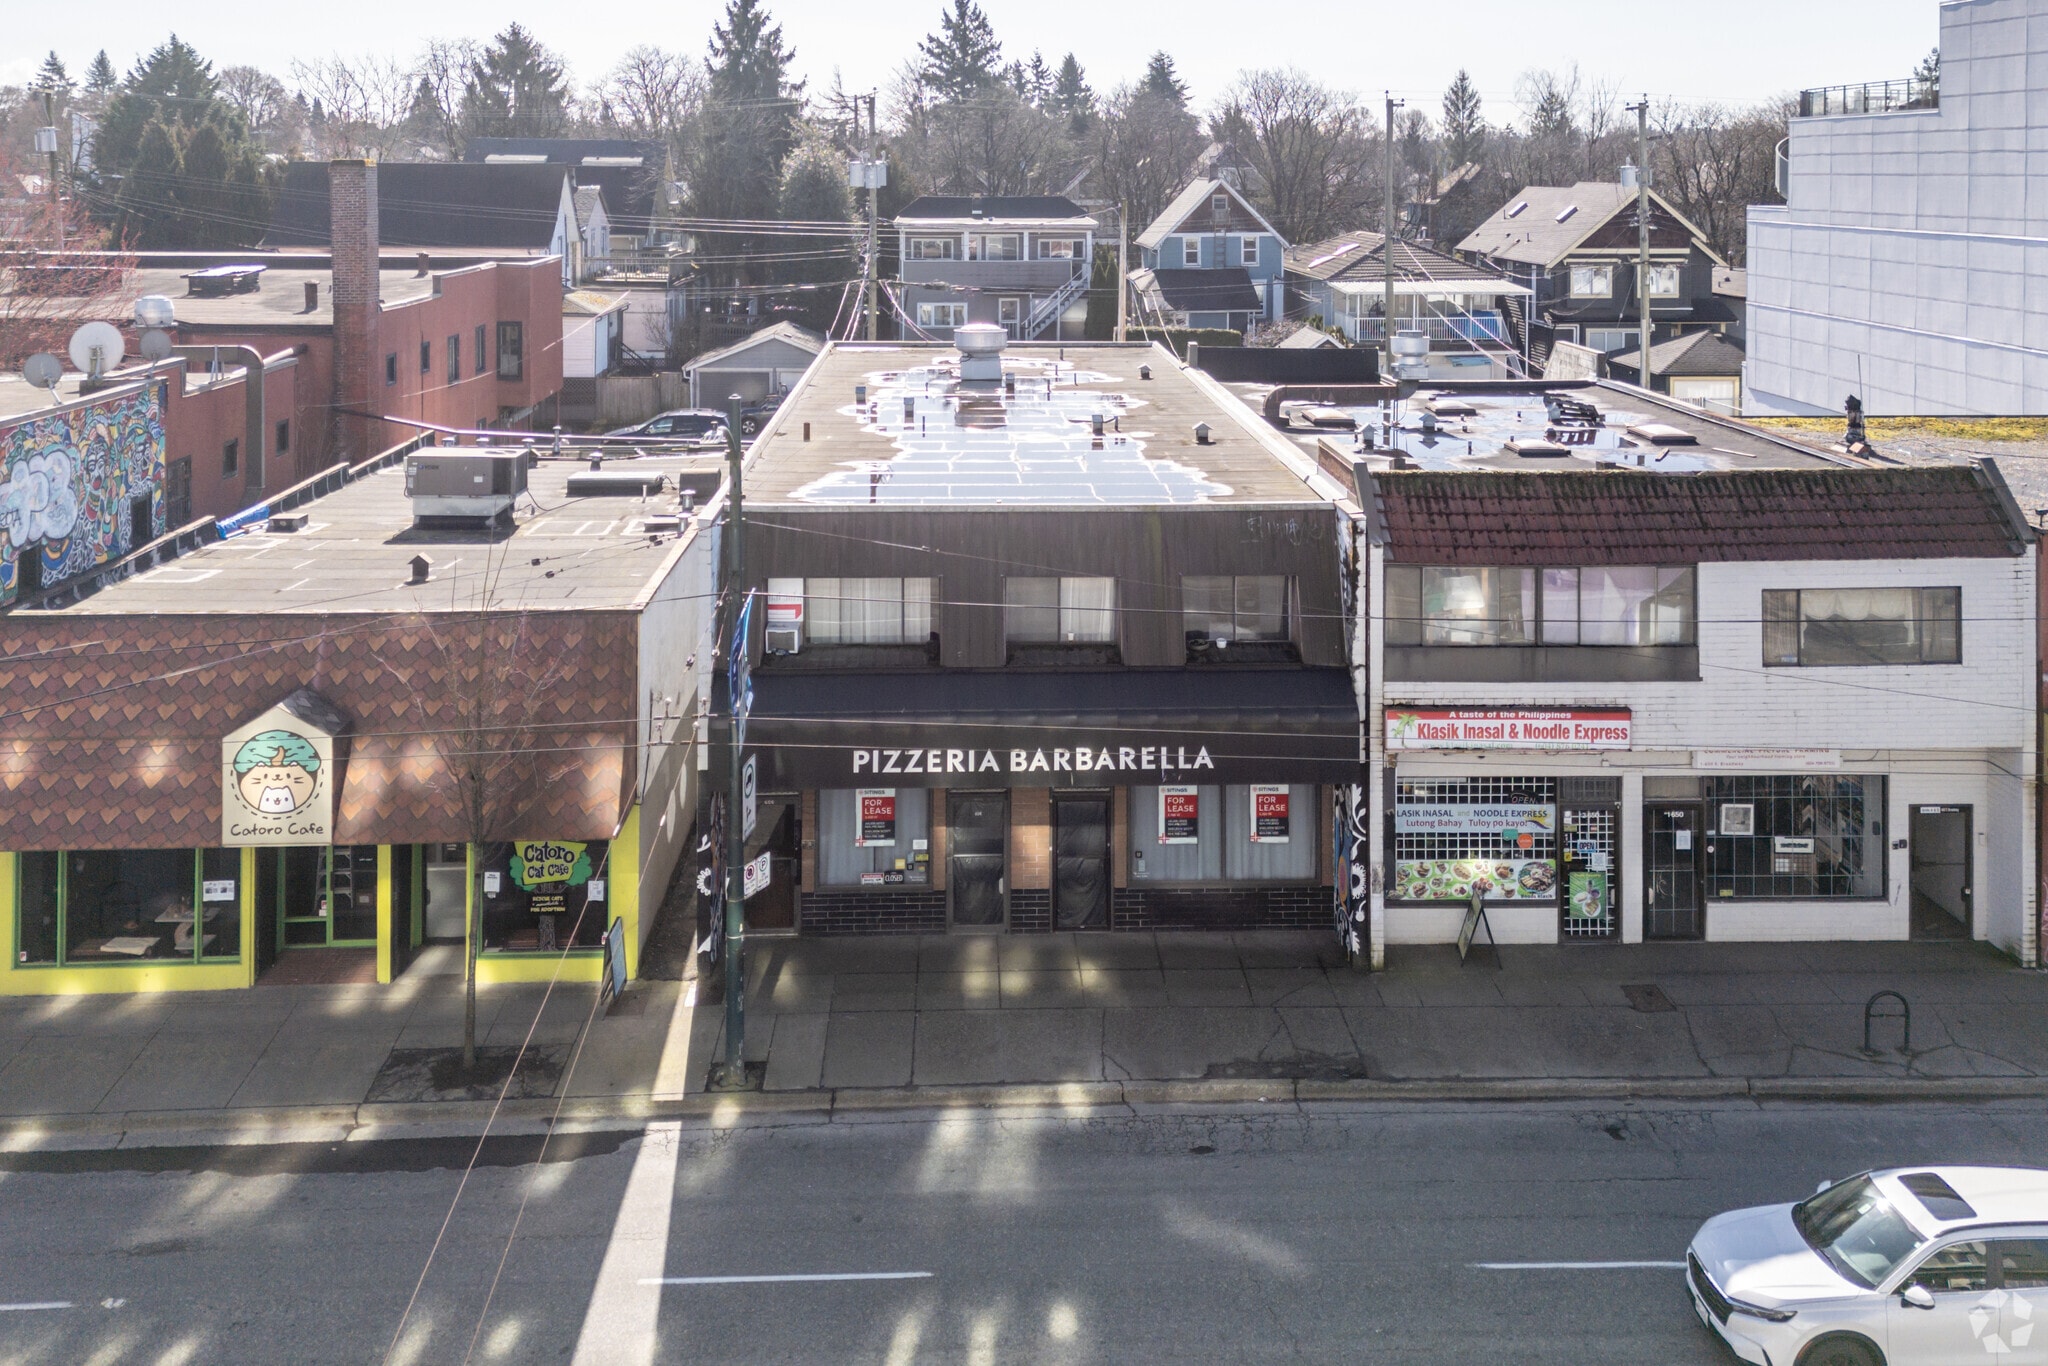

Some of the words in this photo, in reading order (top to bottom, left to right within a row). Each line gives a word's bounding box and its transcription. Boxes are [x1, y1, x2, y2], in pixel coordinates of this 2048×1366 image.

[1449, 711, 1456, 719] A
[1459, 711, 1484, 719] taste
[1487, 711, 1497, 719] of
[1500, 711, 1516, 719] the
[1518, 711, 1572, 720] Philippines
[1417, 723, 1460, 739] Klasik
[1463, 723, 1505, 739] Inasal
[1508, 723, 1519, 739] &
[1523, 723, 1570, 740] Noodle
[1574, 723, 1628, 744] Express
[853, 749, 1001, 773] PIZZERIA
[1009, 746, 1214, 772] BARBARELLA
[864, 799, 882, 807] FOR
[1167, 797, 1185, 805] FOR
[1258, 796, 1276, 804] FOR
[1512, 796, 1536, 804] OPEN
[864, 807, 892, 815] LEASE
[1258, 804, 1286, 812] LEASE
[1423, 809, 1454, 817] INASAL
[1473, 809, 1509, 818] NOODLE
[1511, 810, 1548, 818] EXPRESS
[1406, 819, 1436, 829] Lutong
[1437, 819, 1463, 829] Bahay
[1468, 819, 1491, 829] Tuloy
[1492, 820, 1504, 828] po
[230, 823, 283, 836] Catoro
[288, 822, 324, 835] Cafe
[1579, 842, 1595, 850] OPEN
[524, 842, 575, 863] Catoro
[527, 864, 545, 878] Cat
[547, 863, 569, 876] Cafe
[885, 874, 904, 882] CLOSED
